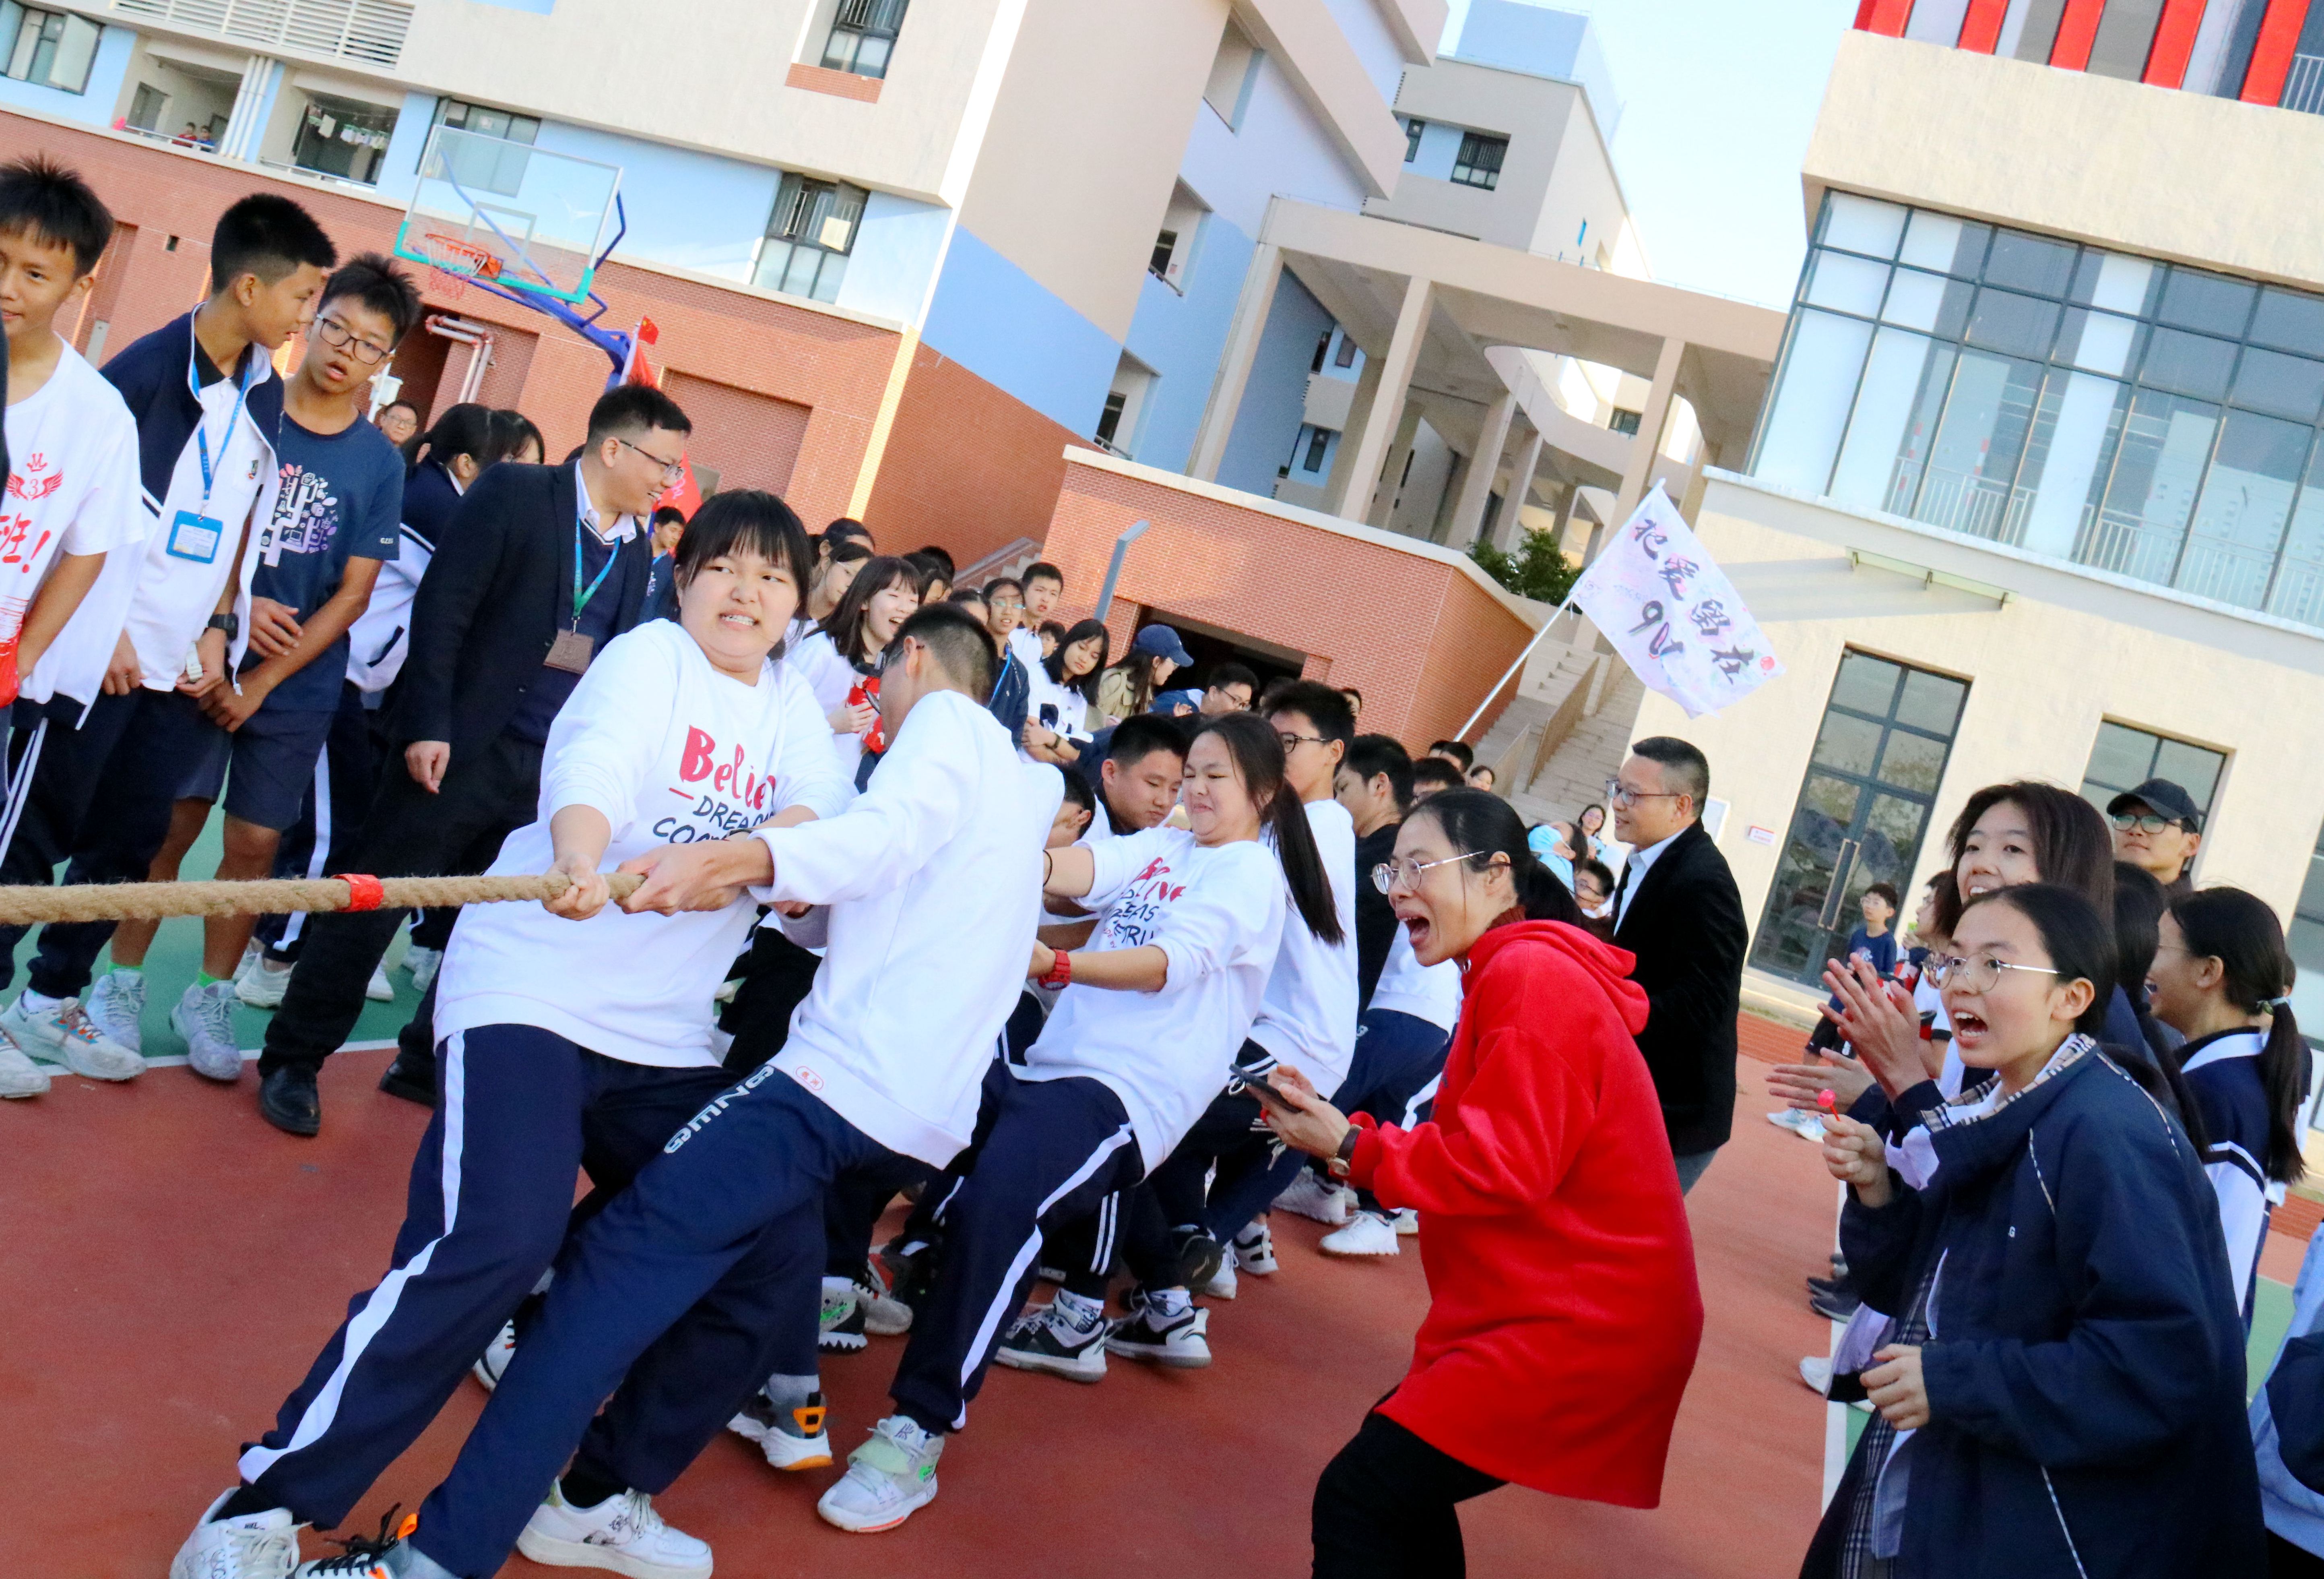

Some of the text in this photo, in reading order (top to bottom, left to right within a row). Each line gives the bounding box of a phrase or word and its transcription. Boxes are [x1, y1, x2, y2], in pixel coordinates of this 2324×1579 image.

[28, 478, 39, 496] 3
[1635, 519, 1754, 684] 把爱留在
